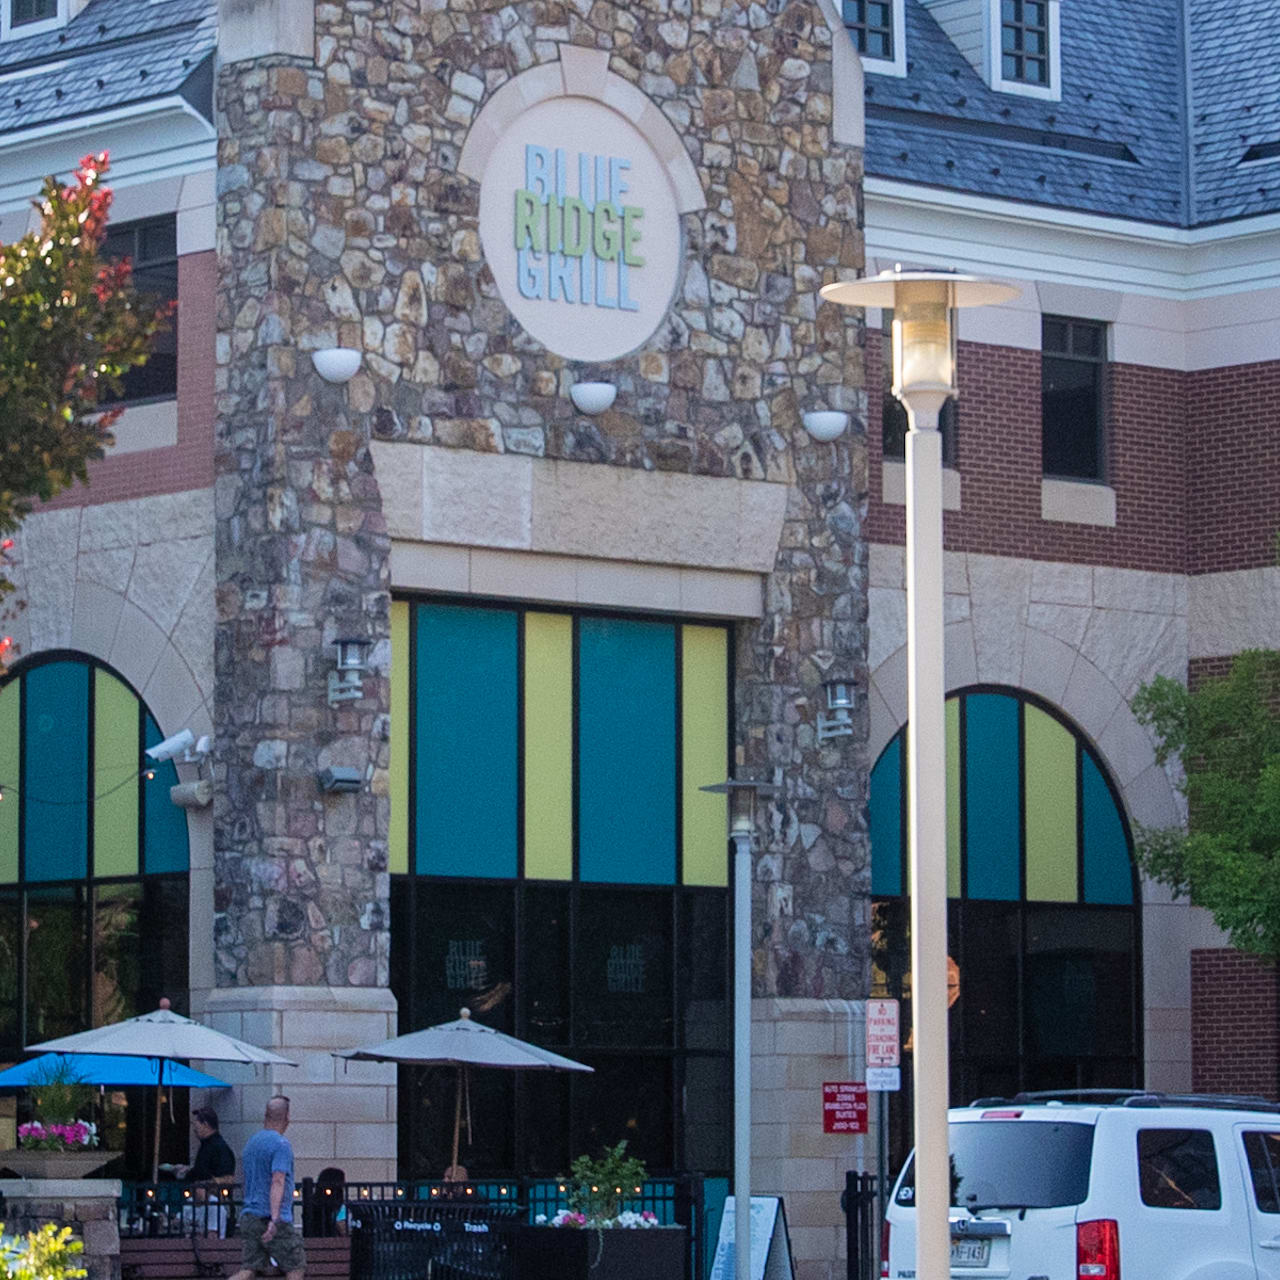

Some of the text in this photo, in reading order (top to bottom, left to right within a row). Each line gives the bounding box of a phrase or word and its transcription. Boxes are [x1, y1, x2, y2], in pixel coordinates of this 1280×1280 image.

[525, 143, 631, 217] BLUE
[514, 188, 646, 267] RIDGE
[516, 233, 640, 313] GRILL
[403, 1220, 432, 1231] Recycle
[463, 1222, 489, 1233] Trash
